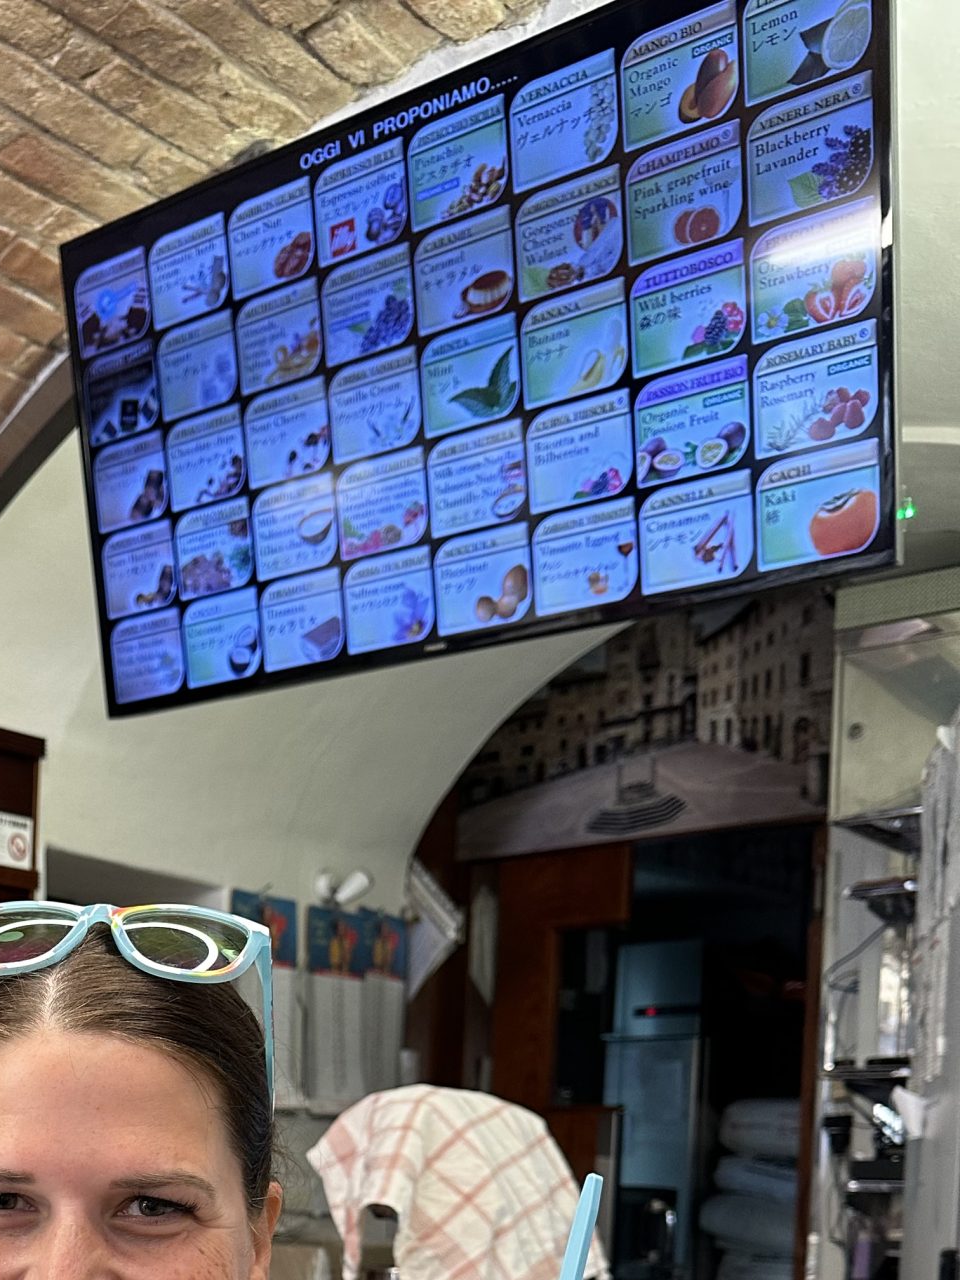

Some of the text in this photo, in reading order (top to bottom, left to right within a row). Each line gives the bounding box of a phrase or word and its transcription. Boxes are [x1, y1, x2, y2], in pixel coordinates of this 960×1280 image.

[751, 3, 798, 37] Lemon
[632, 19, 702, 59] MANGO BIO
[692, 32, 731, 57] ORGANIC
[752, 23, 797, 54] レモン
[628, 52, 678, 87] Organic
[521, 67, 588, 105] VERNACCIA
[629, 71, 671, 102] Mango
[516, 96, 572, 130] Vernaccia
[759, 102, 811, 133] VENERE
[299, 140, 341, 170] OGGI
[348, 130, 366, 149] VI
[754, 117, 831, 164] Blackberry
[755, 140, 819, 178] Lavander
[633, 154, 731, 203] Pink grapefruit
[633, 186, 694, 224] Sparkling
[522, 227, 564, 254] Cheese
[644, 249, 734, 290] TUTTOBOSCO
[758, 255, 831, 294] Strawberry
[638, 277, 712, 315] Wild berries
[531, 299, 580, 325] BANANA
[527, 323, 570, 349] Banana
[766, 340, 826, 369] ROSEMARY
[828, 354, 871, 376] ORGANIC
[427, 361, 453, 381] Mint
[645, 363, 744, 402] PASSION FRUIT BIO
[759, 366, 816, 395] Raspberry
[759, 382, 815, 410] Rosemary
[641, 401, 689, 427] Organic
[642, 407, 719, 440] Passion Fruit
[768, 463, 811, 485] CACHI
[764, 486, 796, 508] Kaki
[646, 506, 711, 534] Cinnamon
